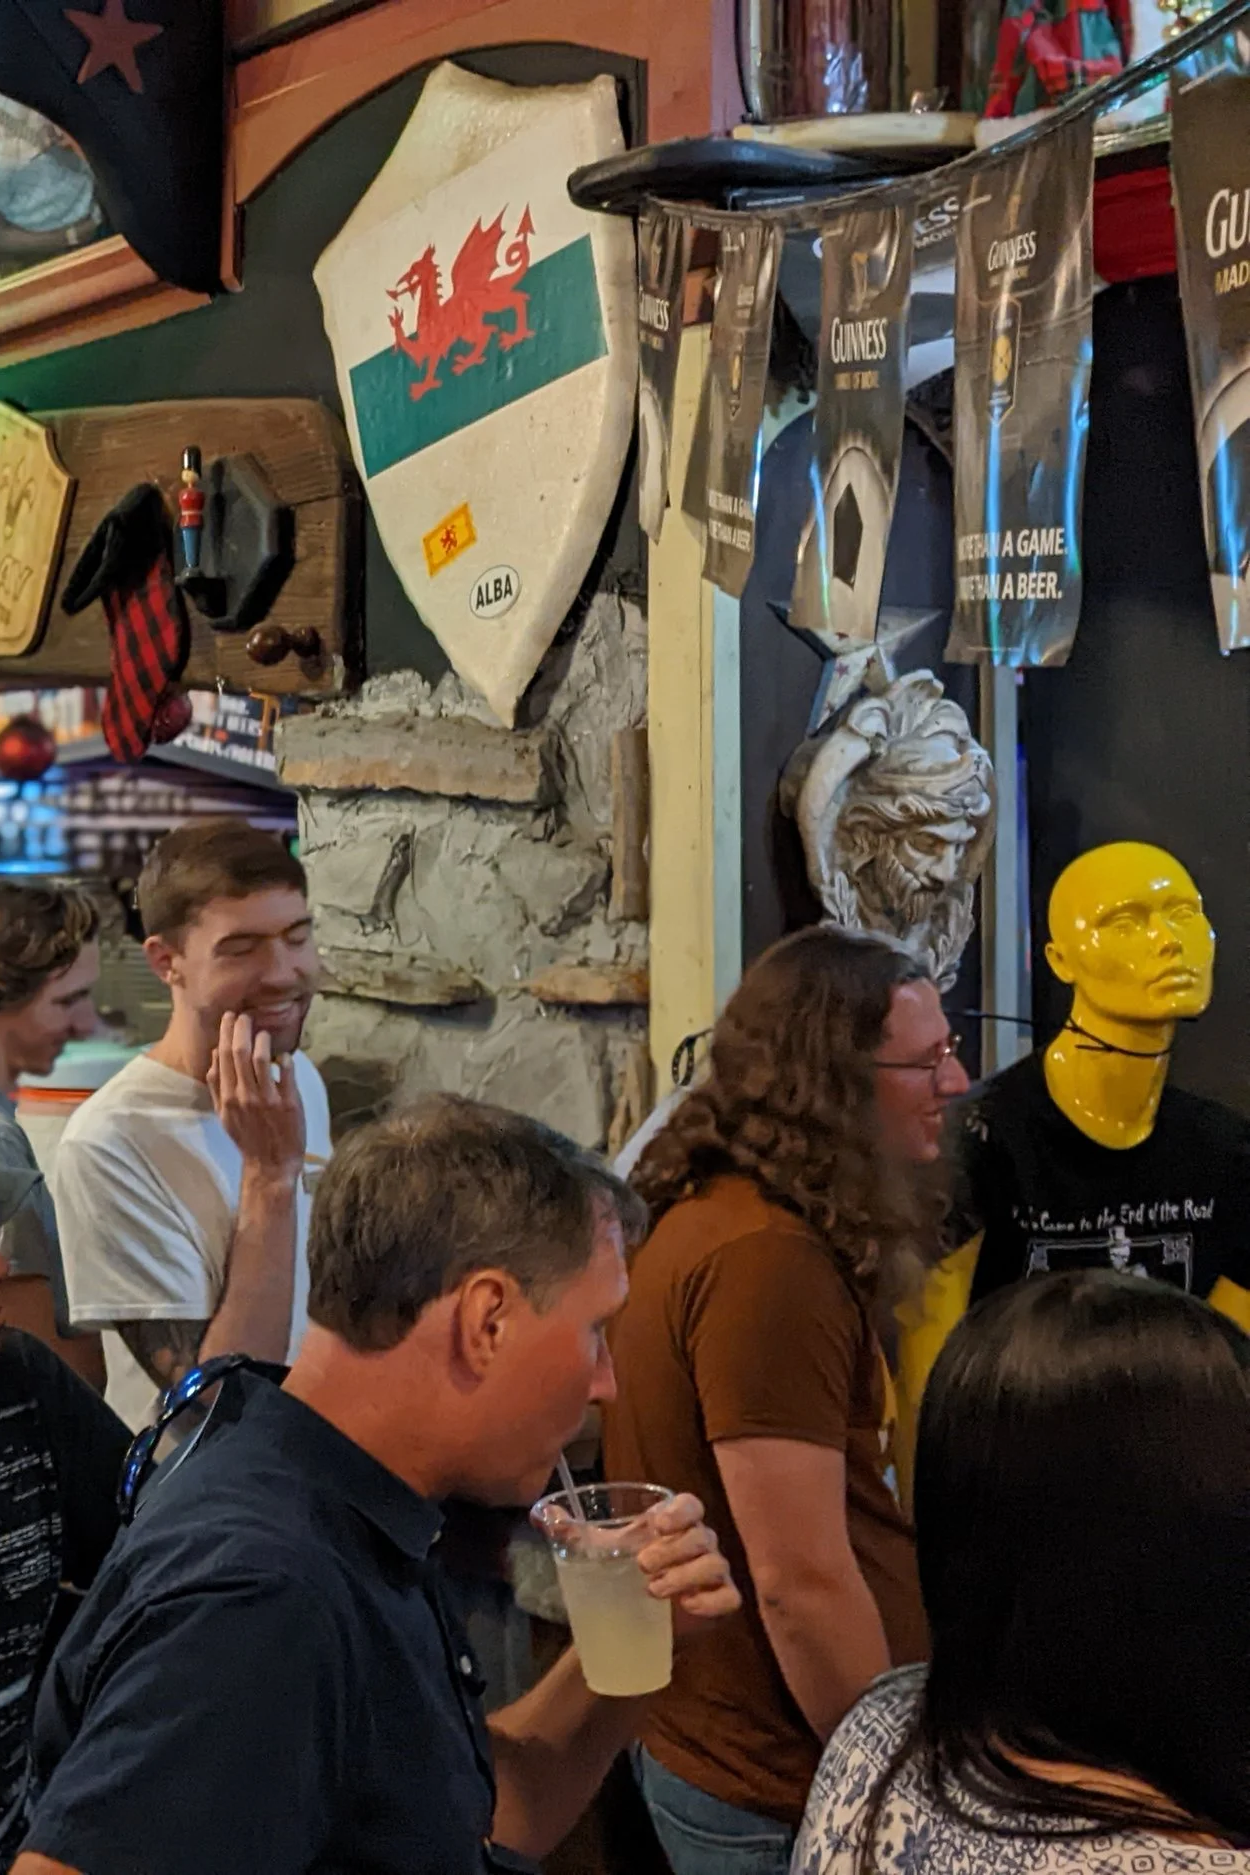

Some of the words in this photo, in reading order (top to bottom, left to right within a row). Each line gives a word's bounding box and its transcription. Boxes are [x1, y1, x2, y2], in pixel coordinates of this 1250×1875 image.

[987, 230, 1037, 272] GUINNESS
[831, 316, 888, 363] GUINNESS
[1001, 530, 1013, 557] A
[1016, 528, 1068, 557] GAME.
[476, 574, 512, 610] ALBA
[1001, 572, 1014, 600] A
[1016, 571, 1063, 600] BEER.
[1120, 1204, 1145, 1224] End
[1184, 1197, 1215, 1221] Road
